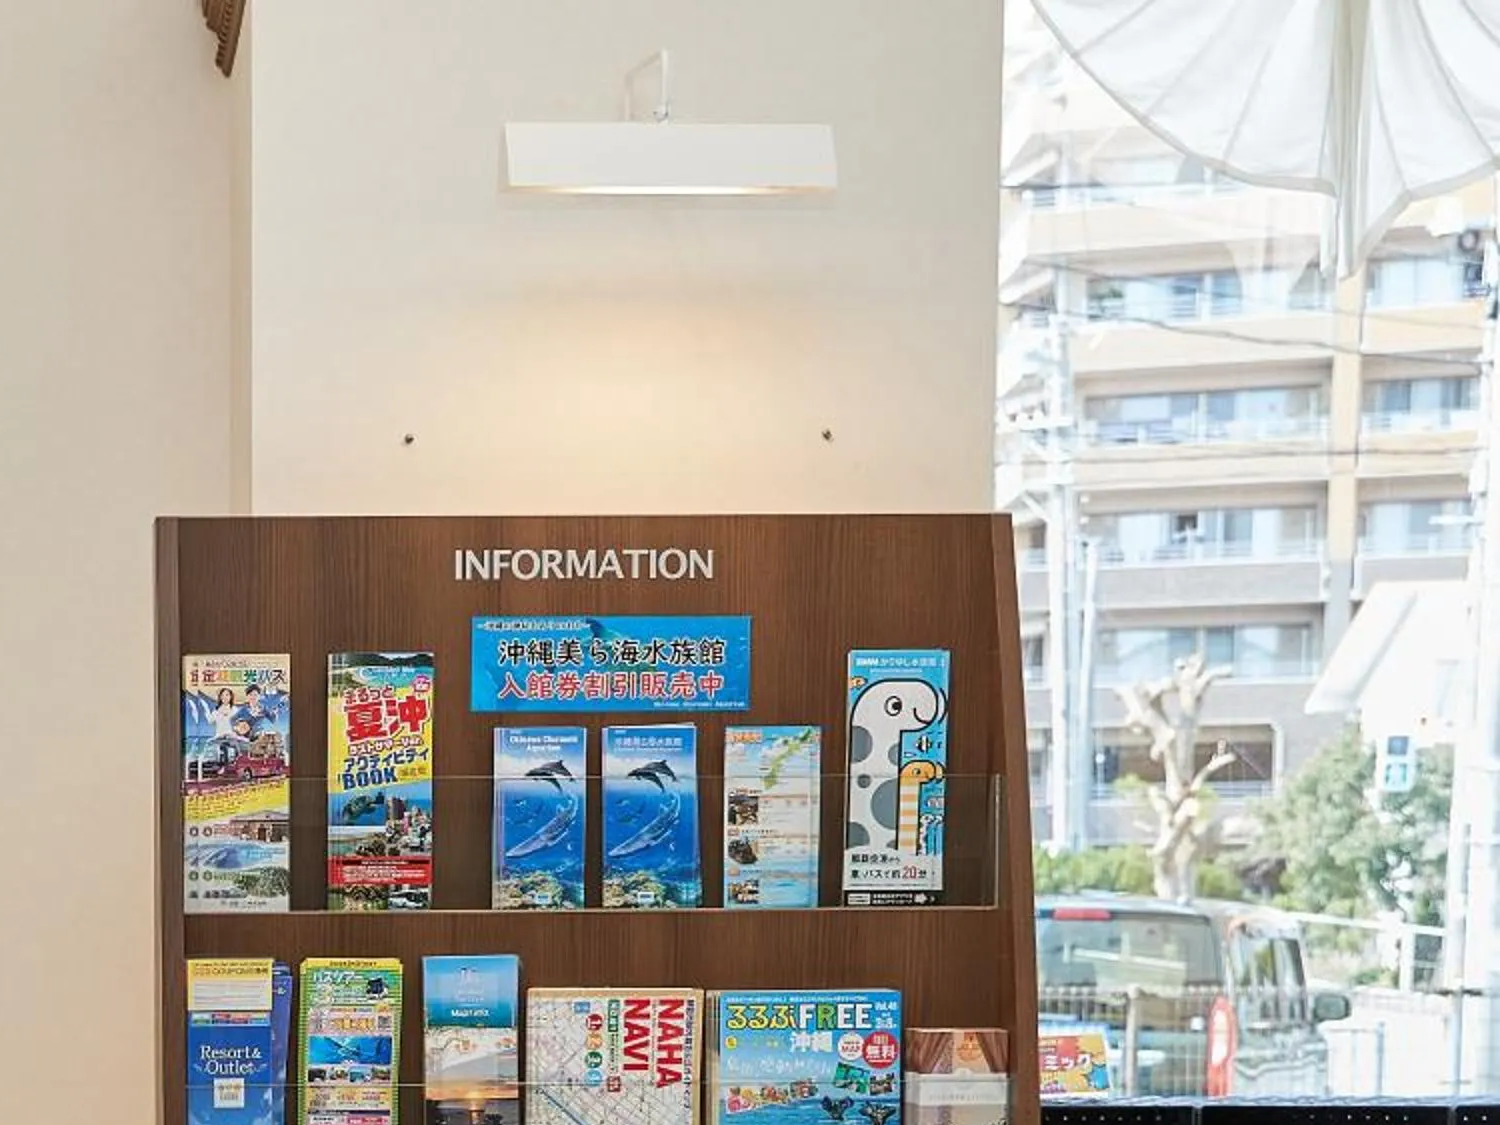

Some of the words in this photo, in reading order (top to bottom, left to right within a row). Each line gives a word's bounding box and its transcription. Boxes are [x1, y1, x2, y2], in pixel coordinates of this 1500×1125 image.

[455, 550, 713, 580] INFORMATION
[499, 638, 725, 666] 沖縄美ら海水族館
[499, 671, 724, 700] 入館券割引販売中
[799, 1003, 873, 1029] FREE
[624, 999, 651, 1071] NAVI
[657, 999, 685, 1089] NAHA
